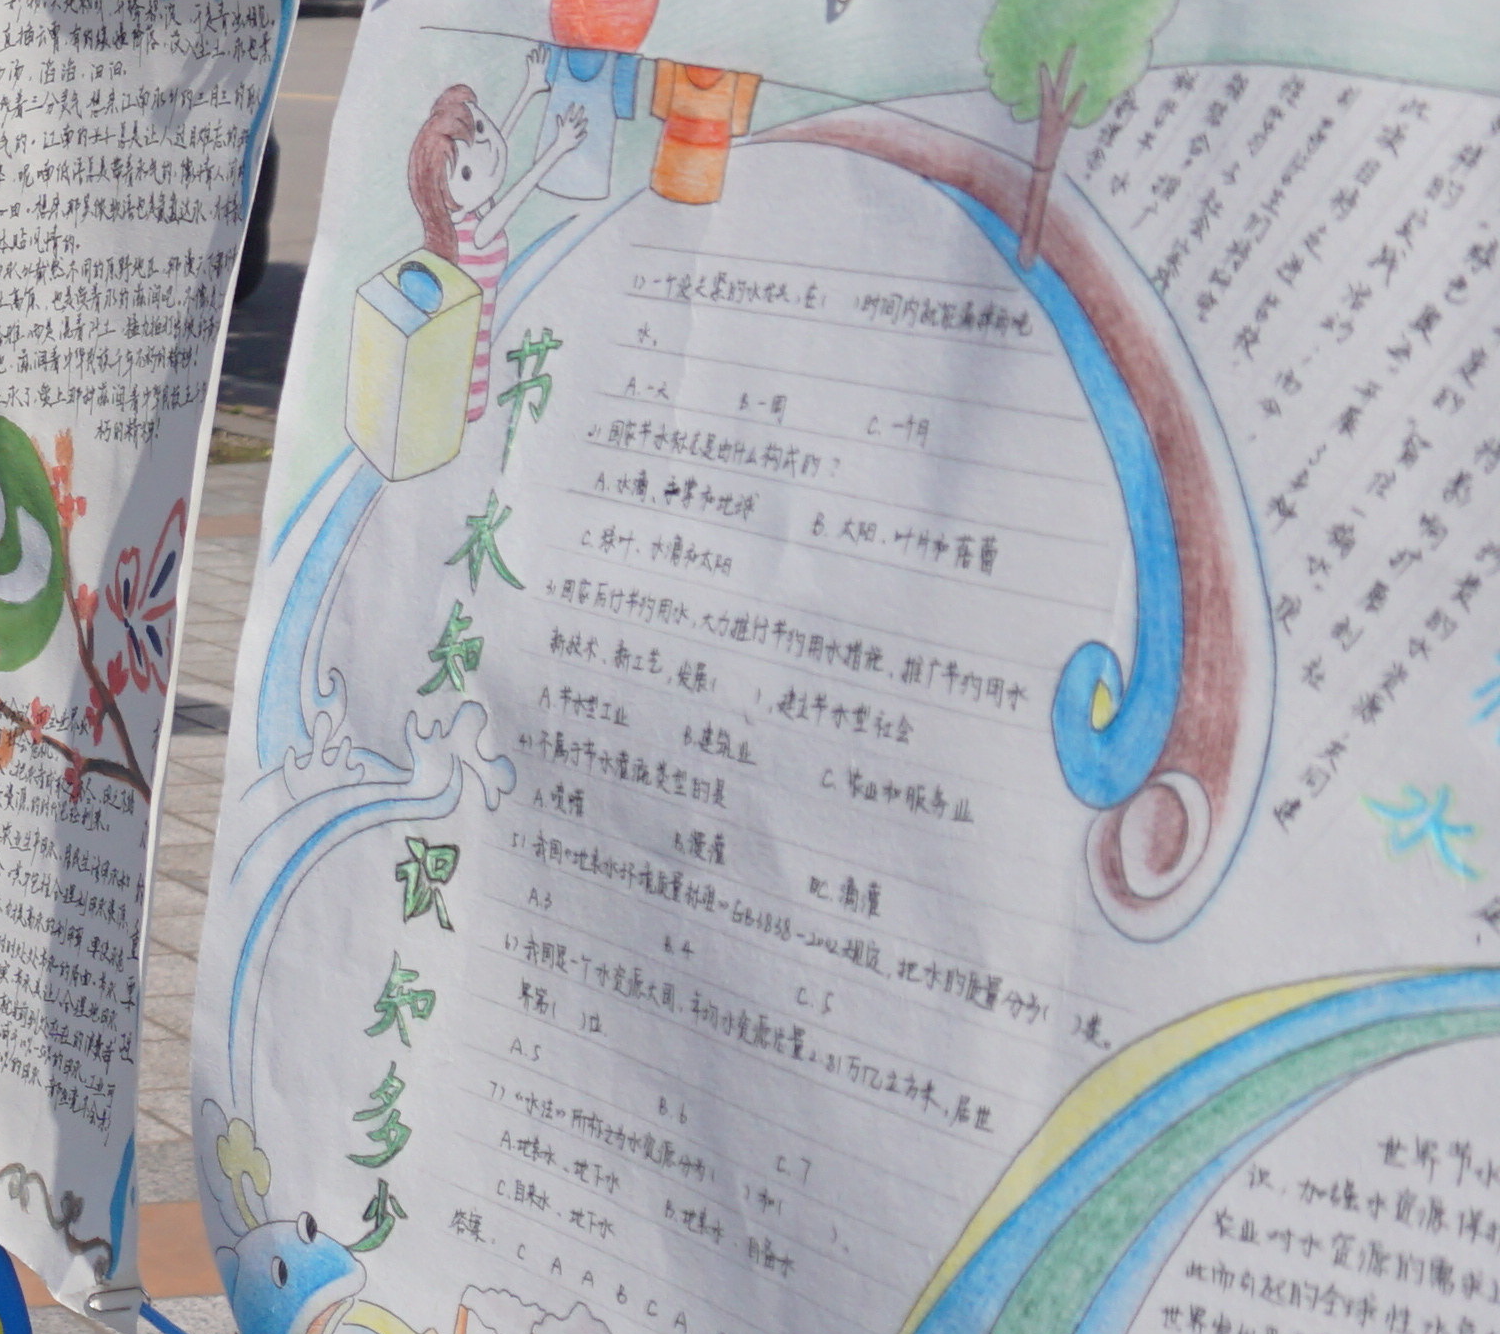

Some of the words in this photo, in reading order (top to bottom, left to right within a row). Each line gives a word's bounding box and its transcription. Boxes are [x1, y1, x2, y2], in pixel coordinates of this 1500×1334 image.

[549, 1256, 564, 1276] A
[581, 1269, 595, 1288] A
[673, 1310, 689, 1334] A
